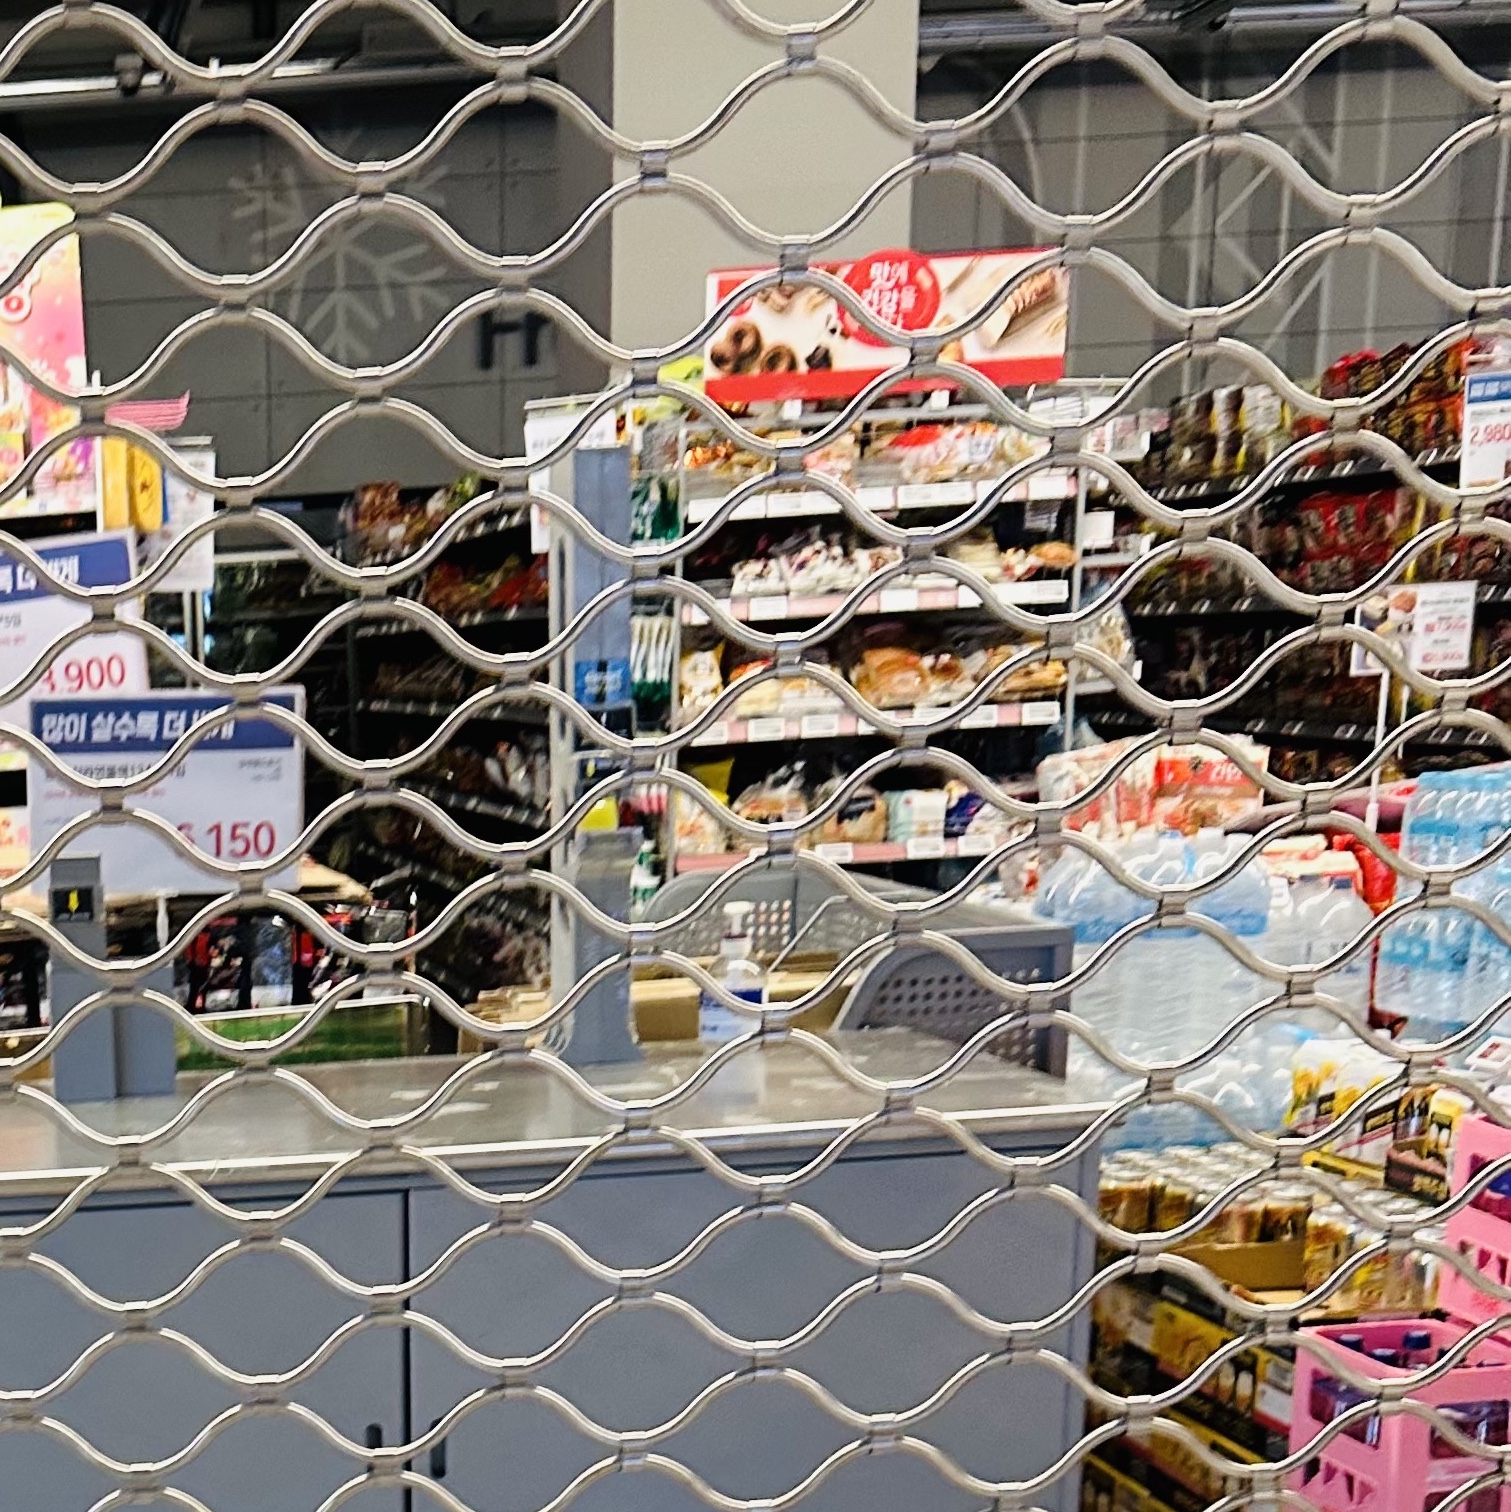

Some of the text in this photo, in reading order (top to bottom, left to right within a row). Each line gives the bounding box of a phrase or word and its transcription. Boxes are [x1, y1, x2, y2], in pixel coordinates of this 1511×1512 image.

[41, 711, 88, 744] 많이
[91, 709, 160, 743] 살수록
[162, 709, 187, 740] 더
